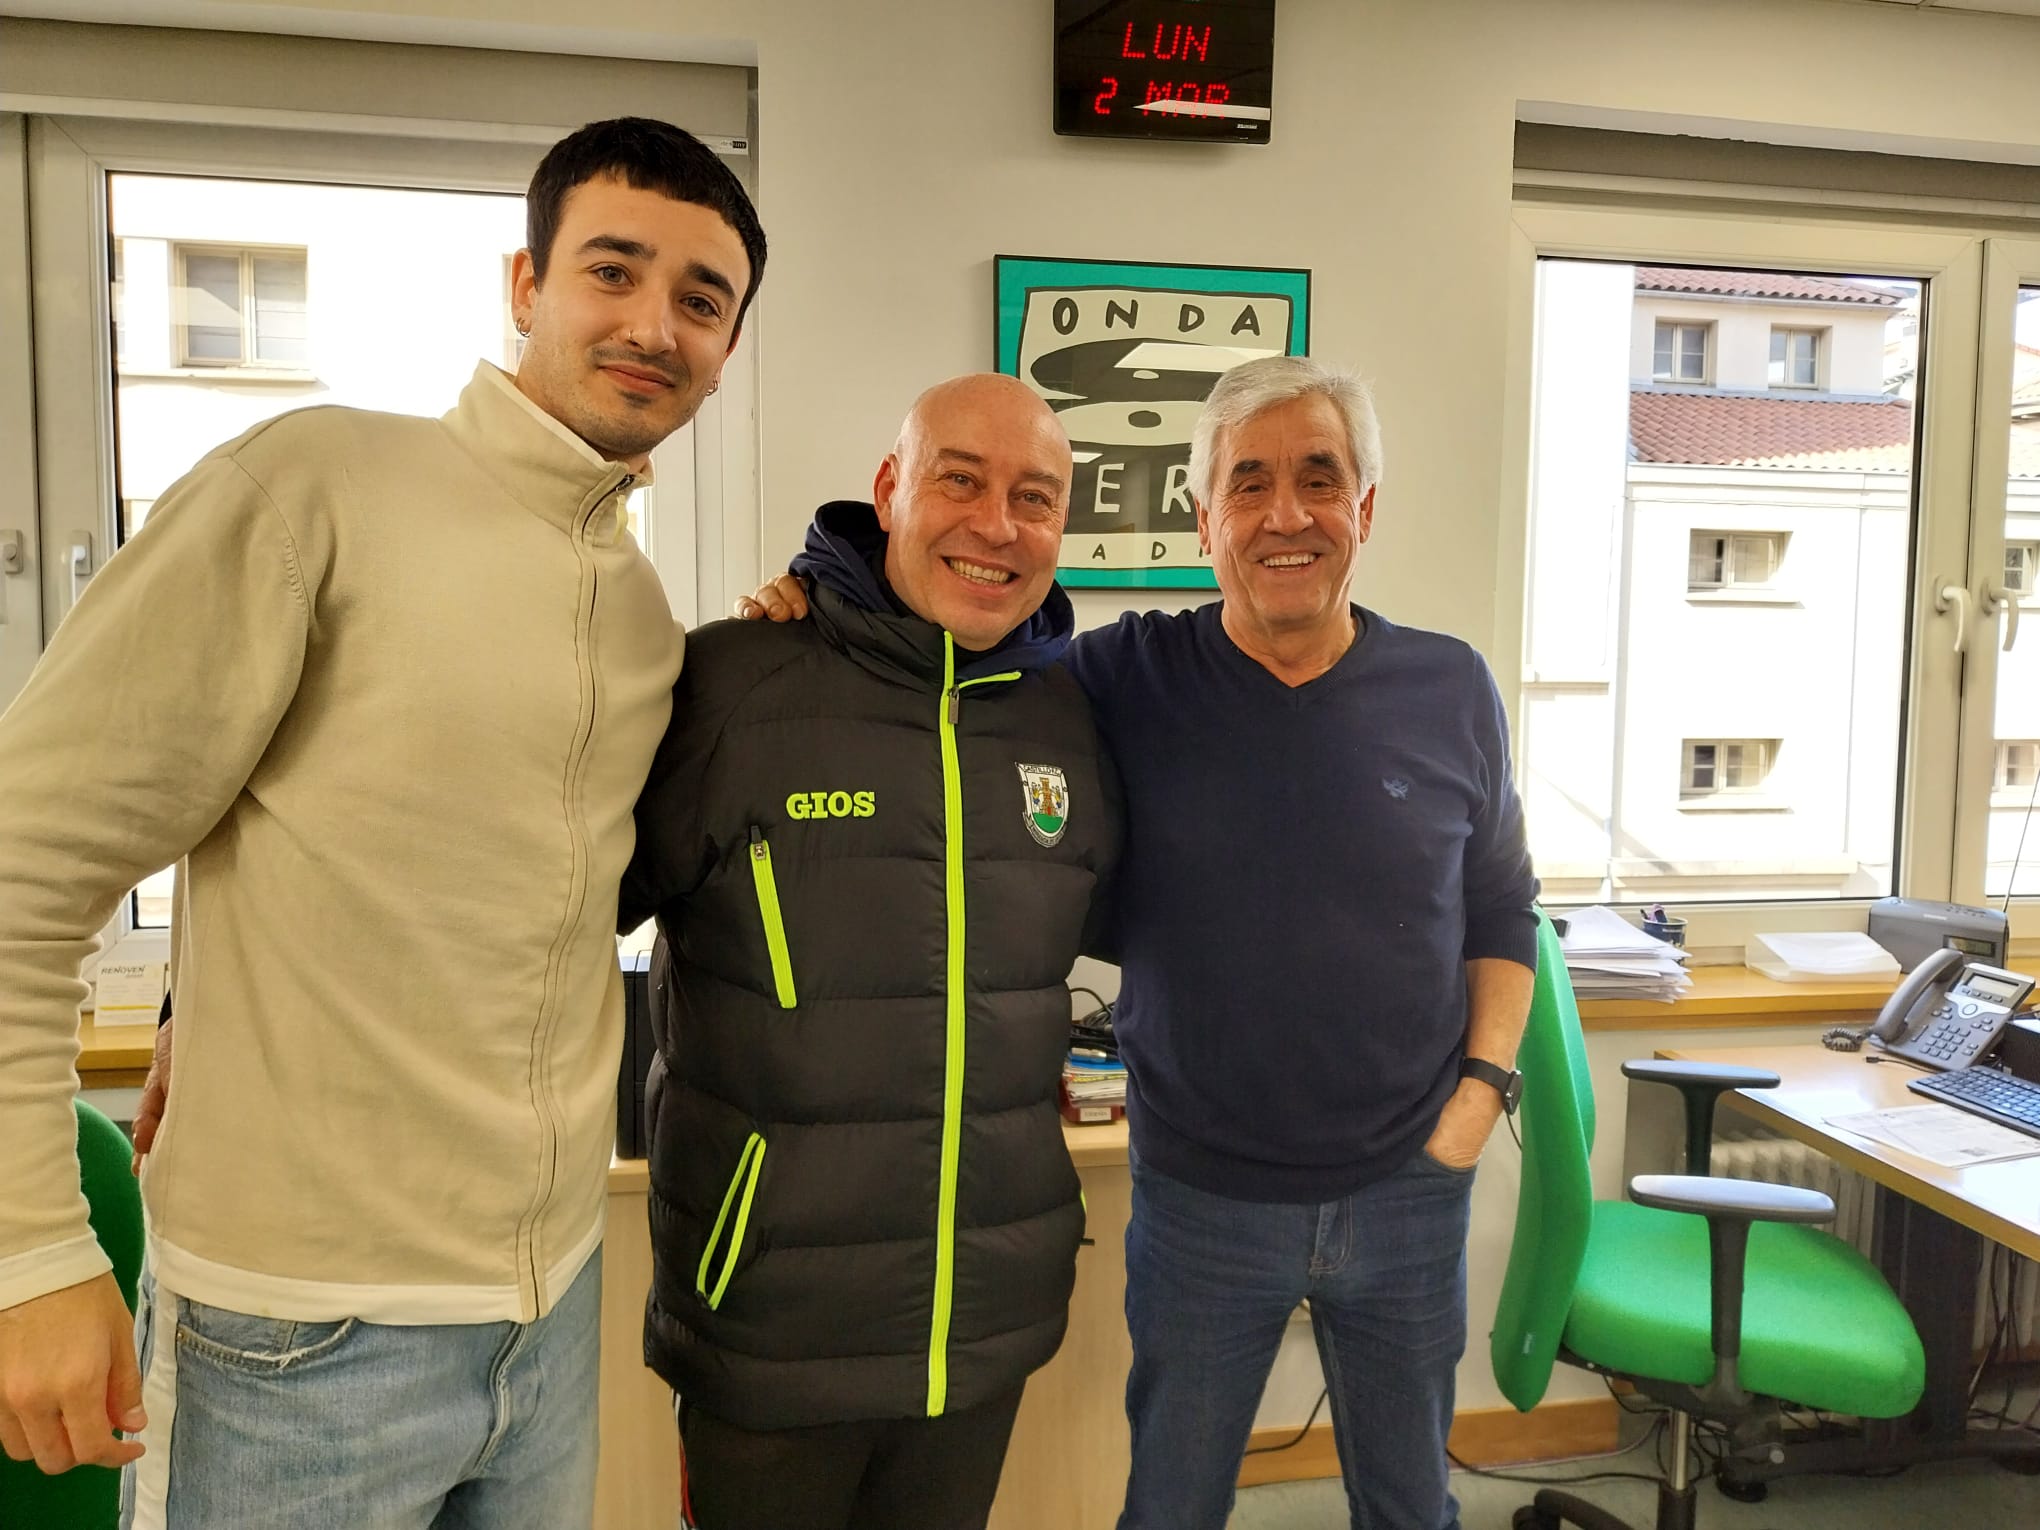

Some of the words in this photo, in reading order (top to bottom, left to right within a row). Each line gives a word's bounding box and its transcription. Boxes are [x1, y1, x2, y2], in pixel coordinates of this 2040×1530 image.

[1122, 22, 1211, 61] LUN
[1094, 77, 1118, 115] 2
[1143, 81, 1230, 119] MAR
[1053, 297, 1261, 336] ONDA
[1094, 463, 1192, 514] ER
[786, 791, 876, 820] GIOS
